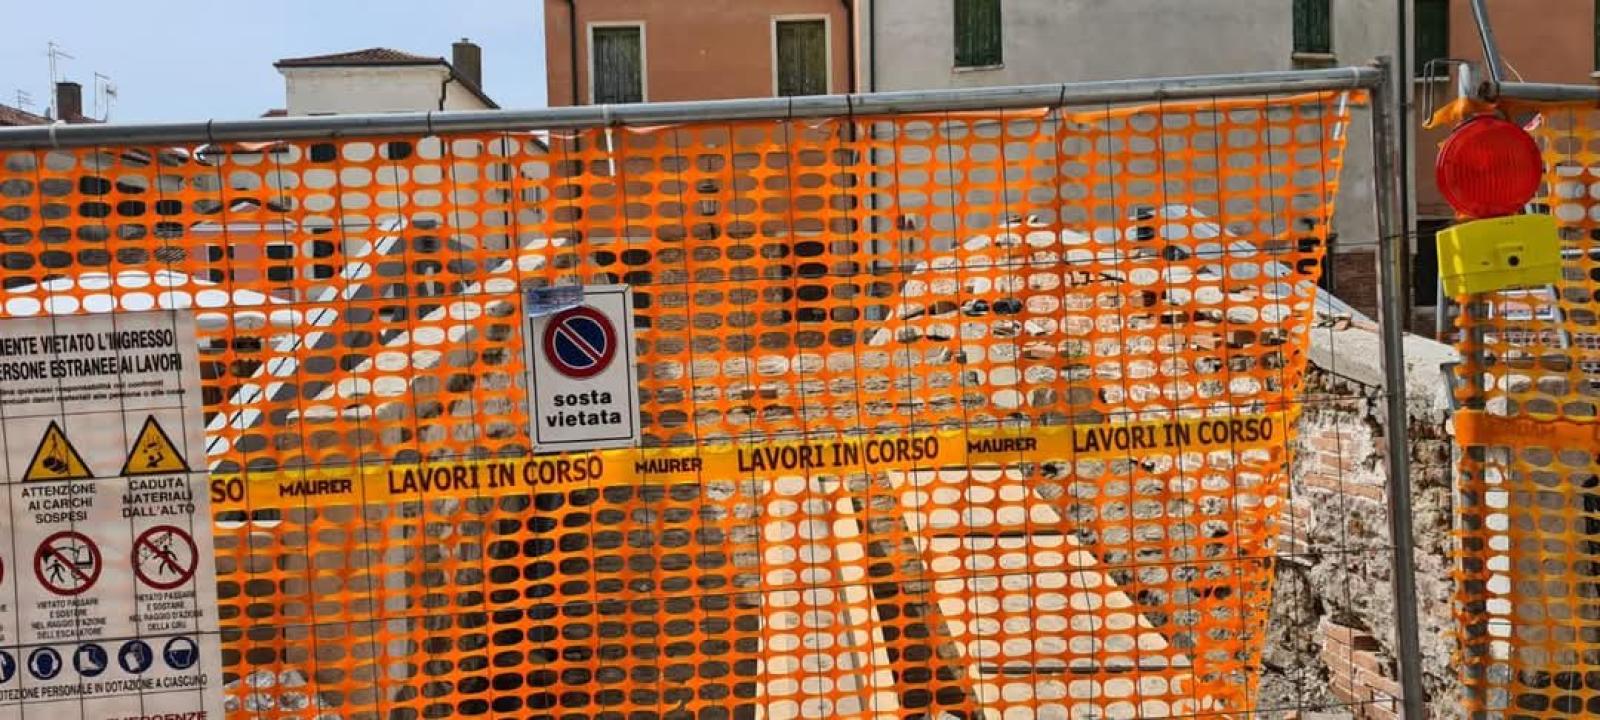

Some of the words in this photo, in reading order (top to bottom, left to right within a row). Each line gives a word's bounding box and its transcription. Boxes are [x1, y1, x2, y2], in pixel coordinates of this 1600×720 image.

[40, 333, 95, 354] VIETATO
[99, 329, 173, 351] L'INGRESSO
[50, 357, 118, 377] ESTRANEE
[120, 355, 133, 374] AI
[136, 353, 182, 373] LAVORI
[554, 389, 612, 407] sosta
[546, 409, 622, 427] vietata
[211, 477, 244, 503] SO
[279, 479, 353, 497] MAURER
[388, 465, 480, 495] LAVORI
[488, 462, 515, 487] IN
[523, 456, 604, 485] CORSO
[634, 456, 703, 475] MAURER
[737, 445, 826, 473] LAVORI
[832, 442, 858, 464] IN
[865, 436, 939, 462] CORSO
[967, 436, 1037, 454] MAURER
[1072, 427, 1157, 453] LAVORI
[1163, 424, 1191, 446] IN
[1197, 417, 1273, 445] CORSO
[21, 483, 96, 498] ATTENZIONE
[129, 478, 184, 491] CADUTA
[28, 499, 41, 511] AI
[43, 497, 93, 510] CARICHI
[122, 490, 193, 504] MATERIALI
[35, 511, 87, 524] SOSPESI
[122, 504, 195, 519] DALL'ALTO
[41, 682, 92, 698] PERSONALE
[95, 682, 104, 694] IN
[105, 678, 154, 693] DOTAZIONE
[156, 678, 163, 689] A
[163, 674, 208, 688] CIASCUNO
